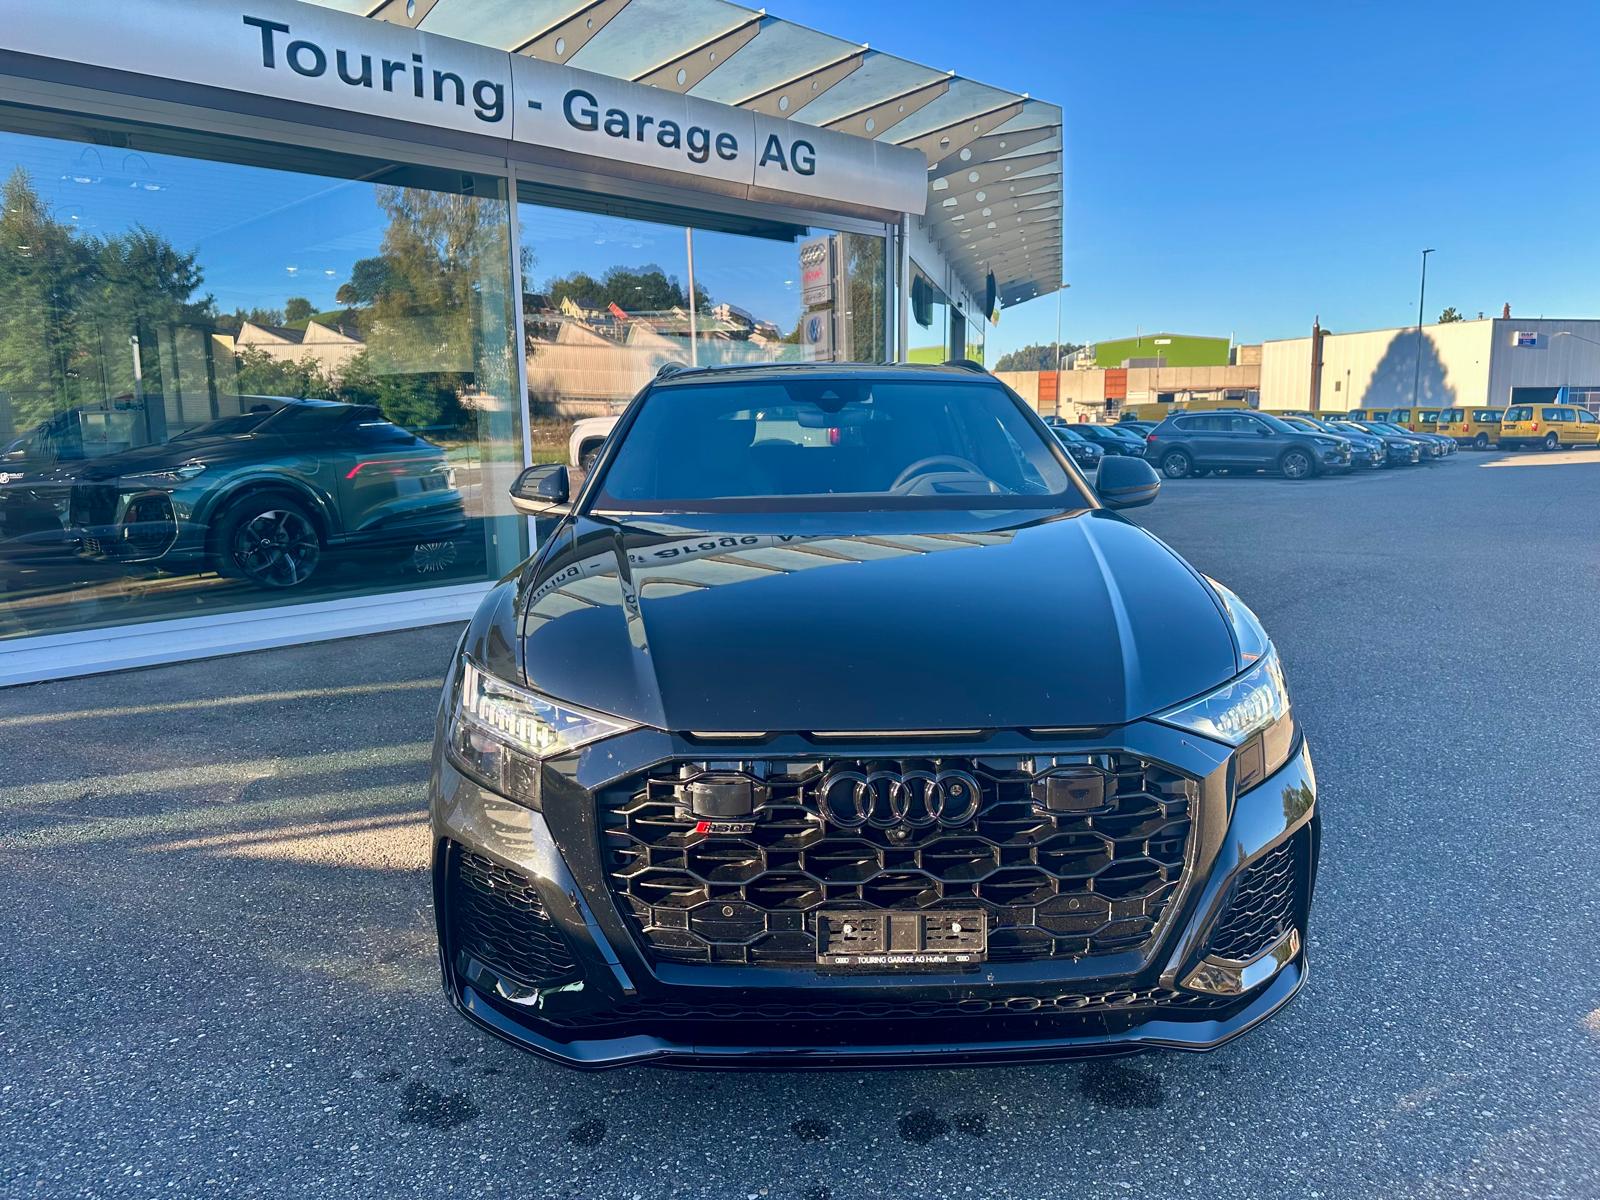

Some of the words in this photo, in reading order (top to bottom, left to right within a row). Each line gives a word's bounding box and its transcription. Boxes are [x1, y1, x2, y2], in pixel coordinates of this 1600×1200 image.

[242, 14, 505, 123] Touring
[528, 100, 543, 111] -
[562, 88, 739, 164] Garage
[758, 133, 818, 177] AG
[857, 956, 887, 964] TOURING
[887, 955, 914, 963] GARAGE
[914, 955, 925, 963] AG
